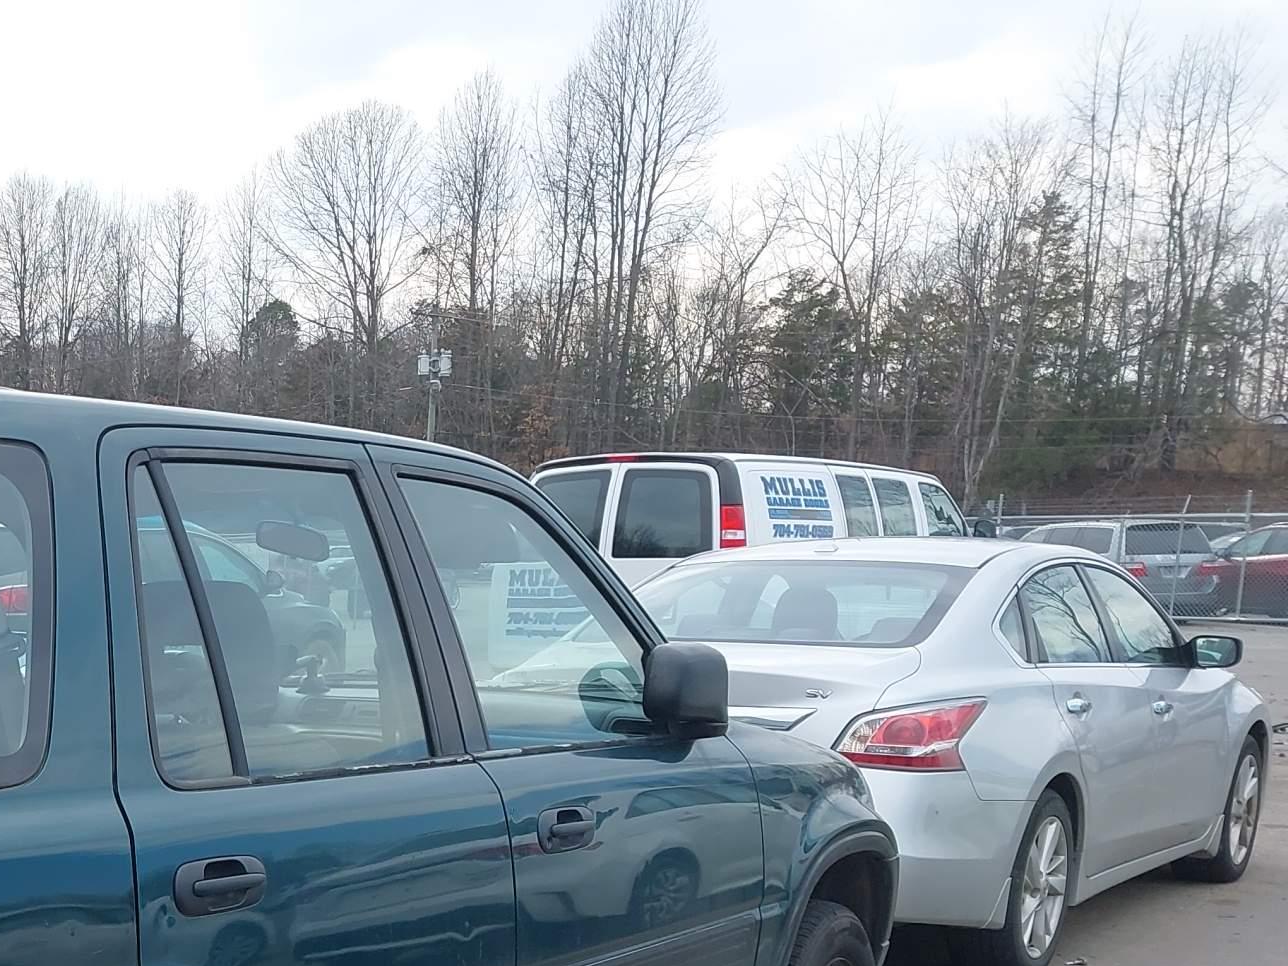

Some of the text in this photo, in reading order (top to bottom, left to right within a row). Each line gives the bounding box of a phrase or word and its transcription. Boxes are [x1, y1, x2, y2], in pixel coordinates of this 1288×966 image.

[760, 476, 827, 498] MULLIS
[766, 496, 830, 509] GARAGE DOORS
[806, 689, 833, 700] SV
